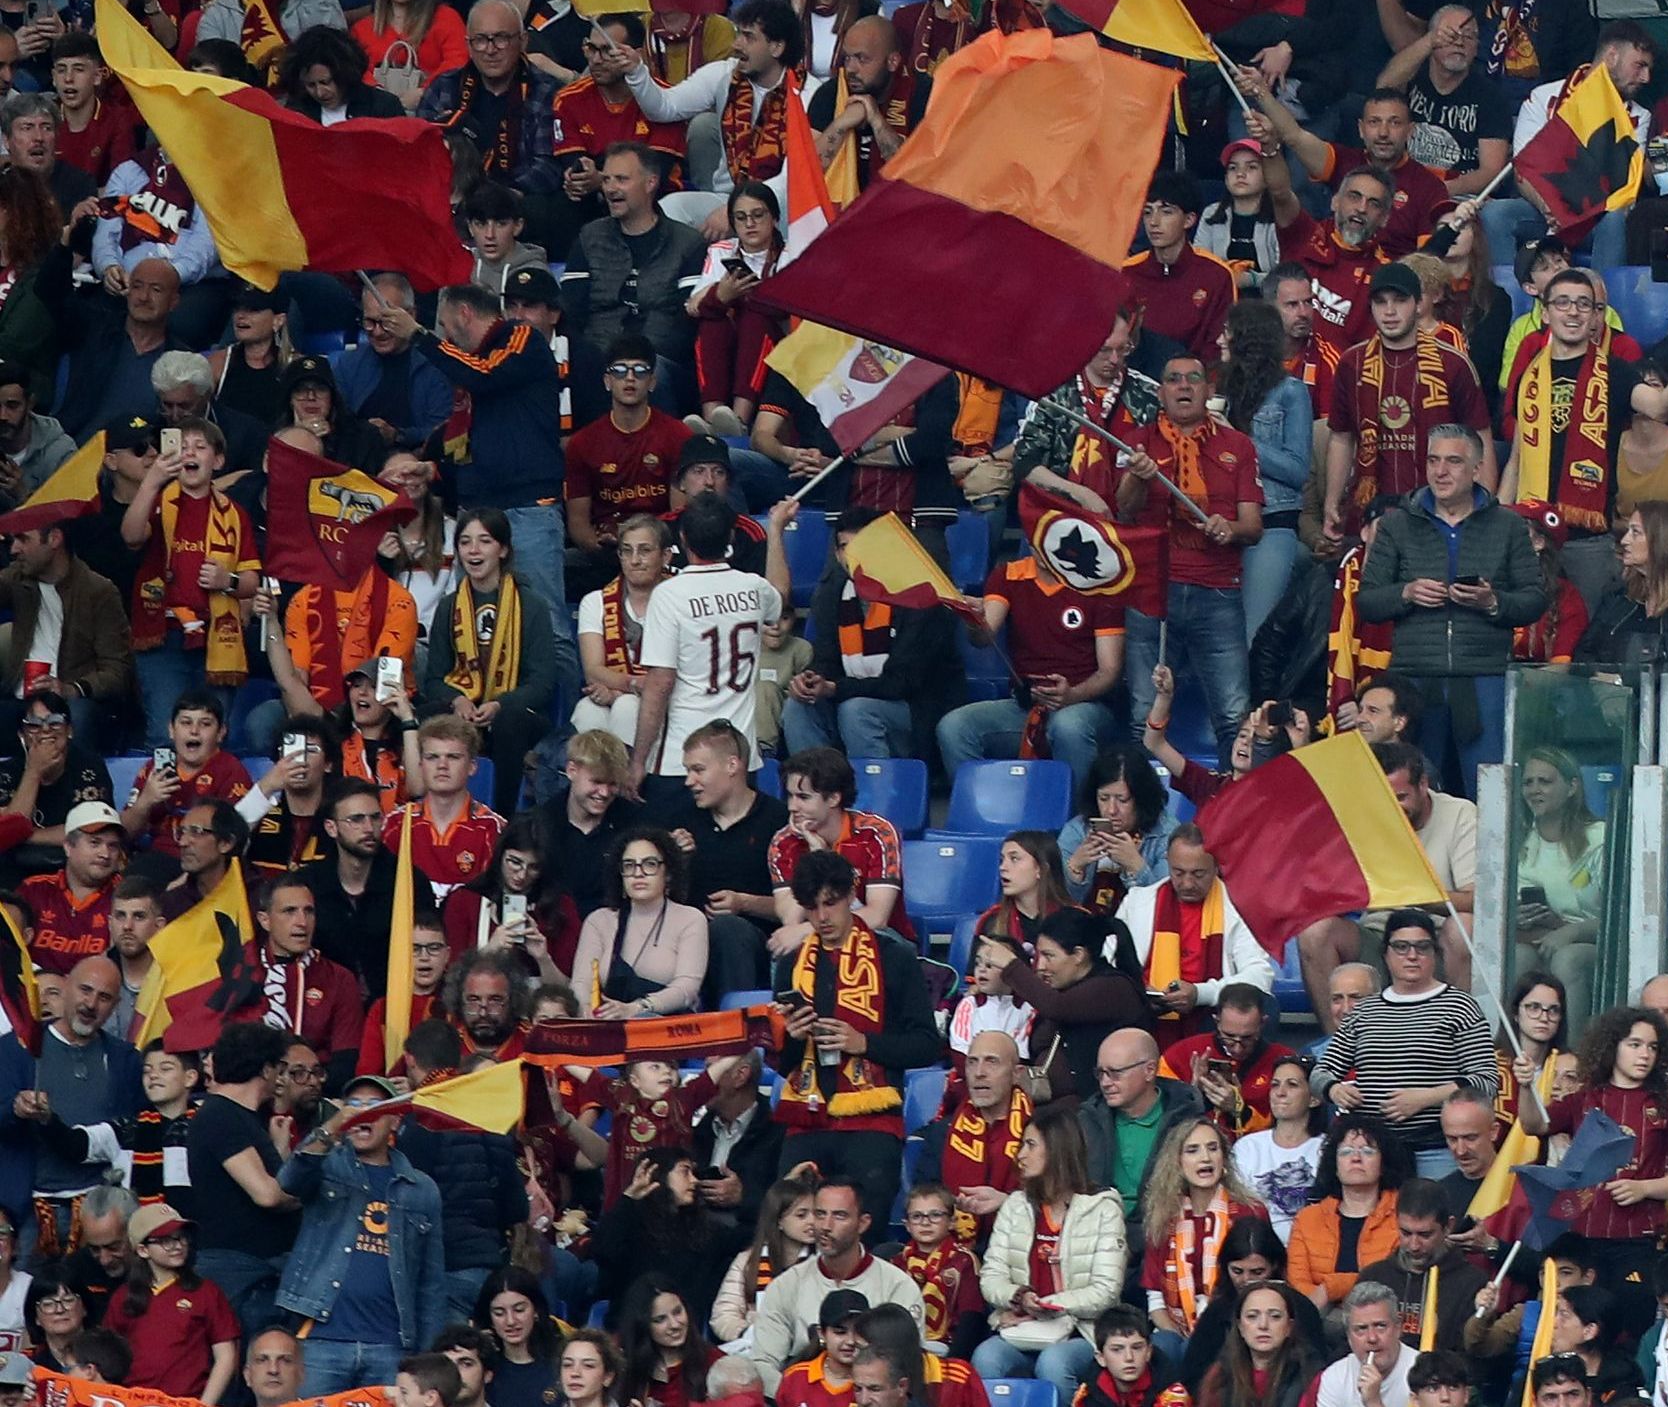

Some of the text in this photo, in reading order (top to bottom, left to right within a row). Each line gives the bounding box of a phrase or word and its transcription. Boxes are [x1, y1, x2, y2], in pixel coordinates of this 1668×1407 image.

[319, 523, 349, 545] RO
[690, 597, 713, 619] DE
[702, 622, 758, 695] 16
[34, 928, 106, 954] Barilla
